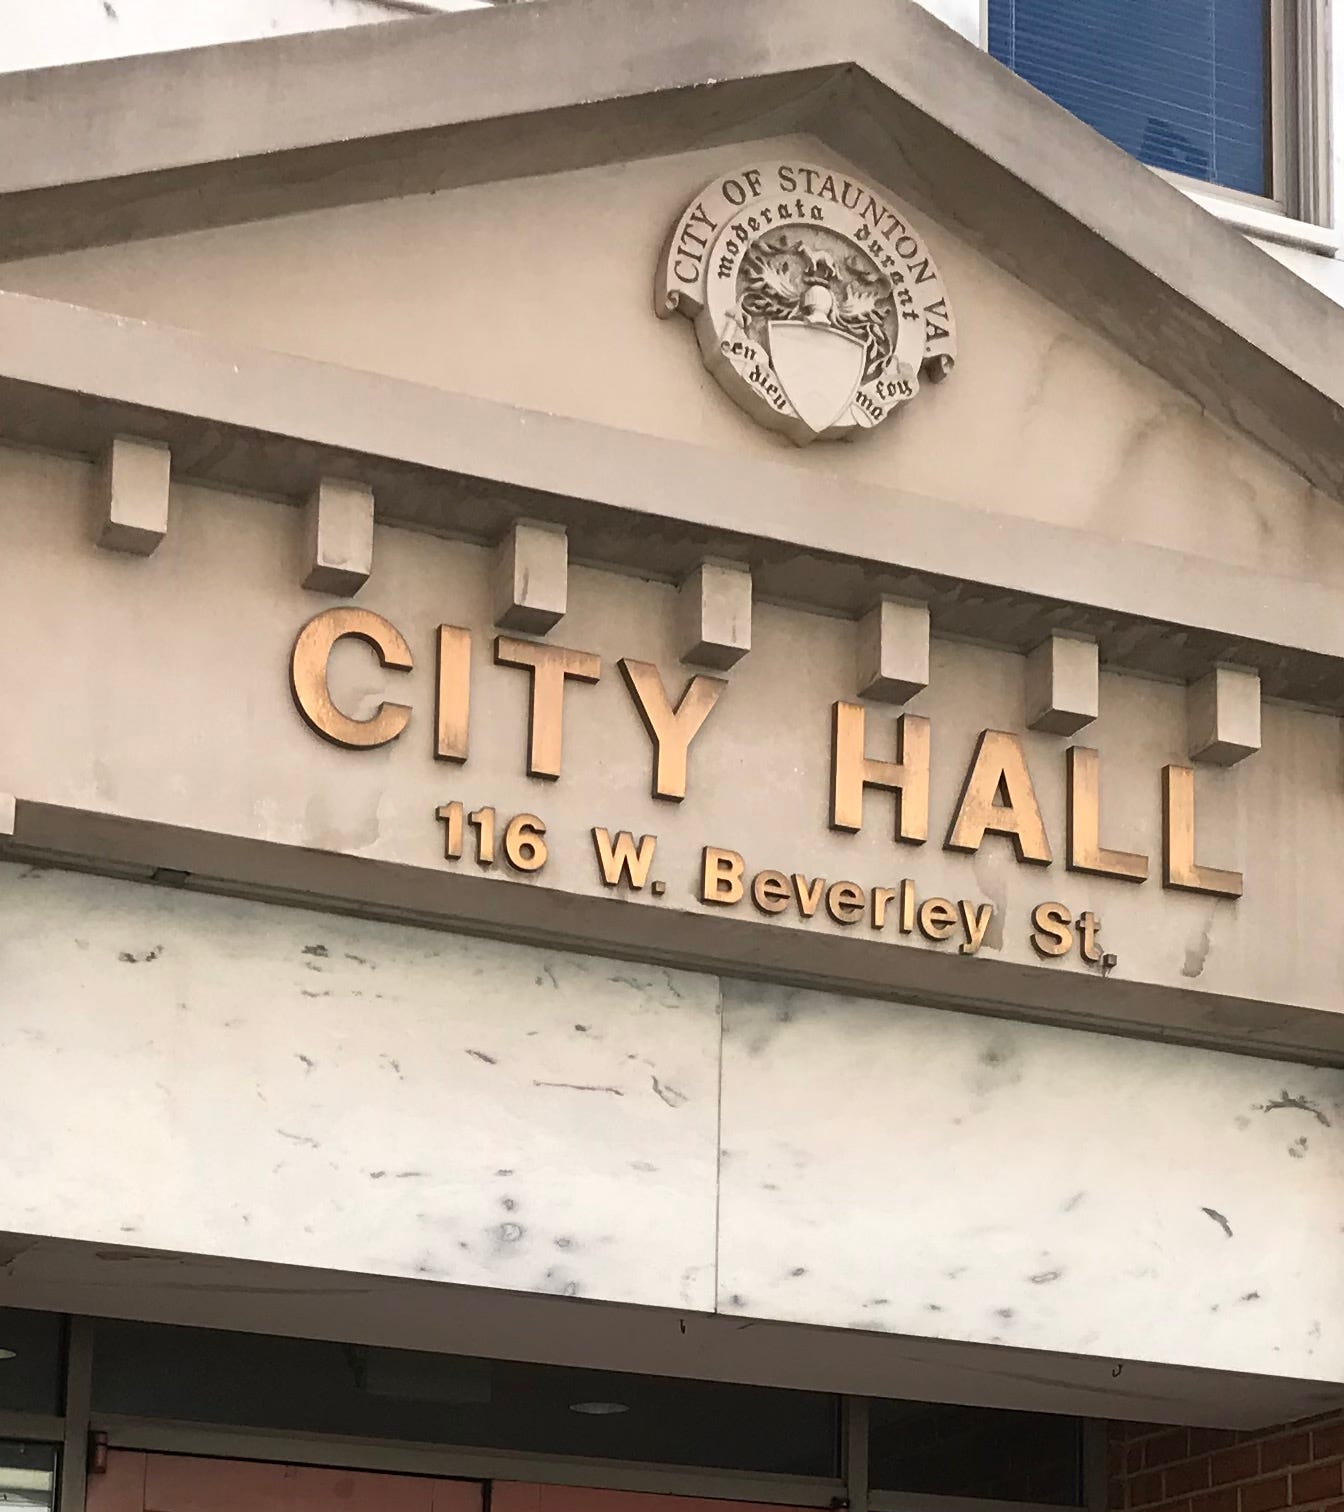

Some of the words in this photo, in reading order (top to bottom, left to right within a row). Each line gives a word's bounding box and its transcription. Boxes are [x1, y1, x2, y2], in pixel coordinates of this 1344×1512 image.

[674, 203, 718, 284] CITY
[722, 169, 761, 206] OF
[778, 166, 937, 284] STAUNTON
[923, 297, 949, 352] VA.
[718, 198, 824, 279] moderata
[289, 606, 729, 803] CITY
[829, 700, 1243, 900] HALL
[436, 801, 547, 872] 116
[591, 827, 666, 896] W.
[701, 846, 993, 955] Beverley
[1030, 902, 1118, 968] St.
